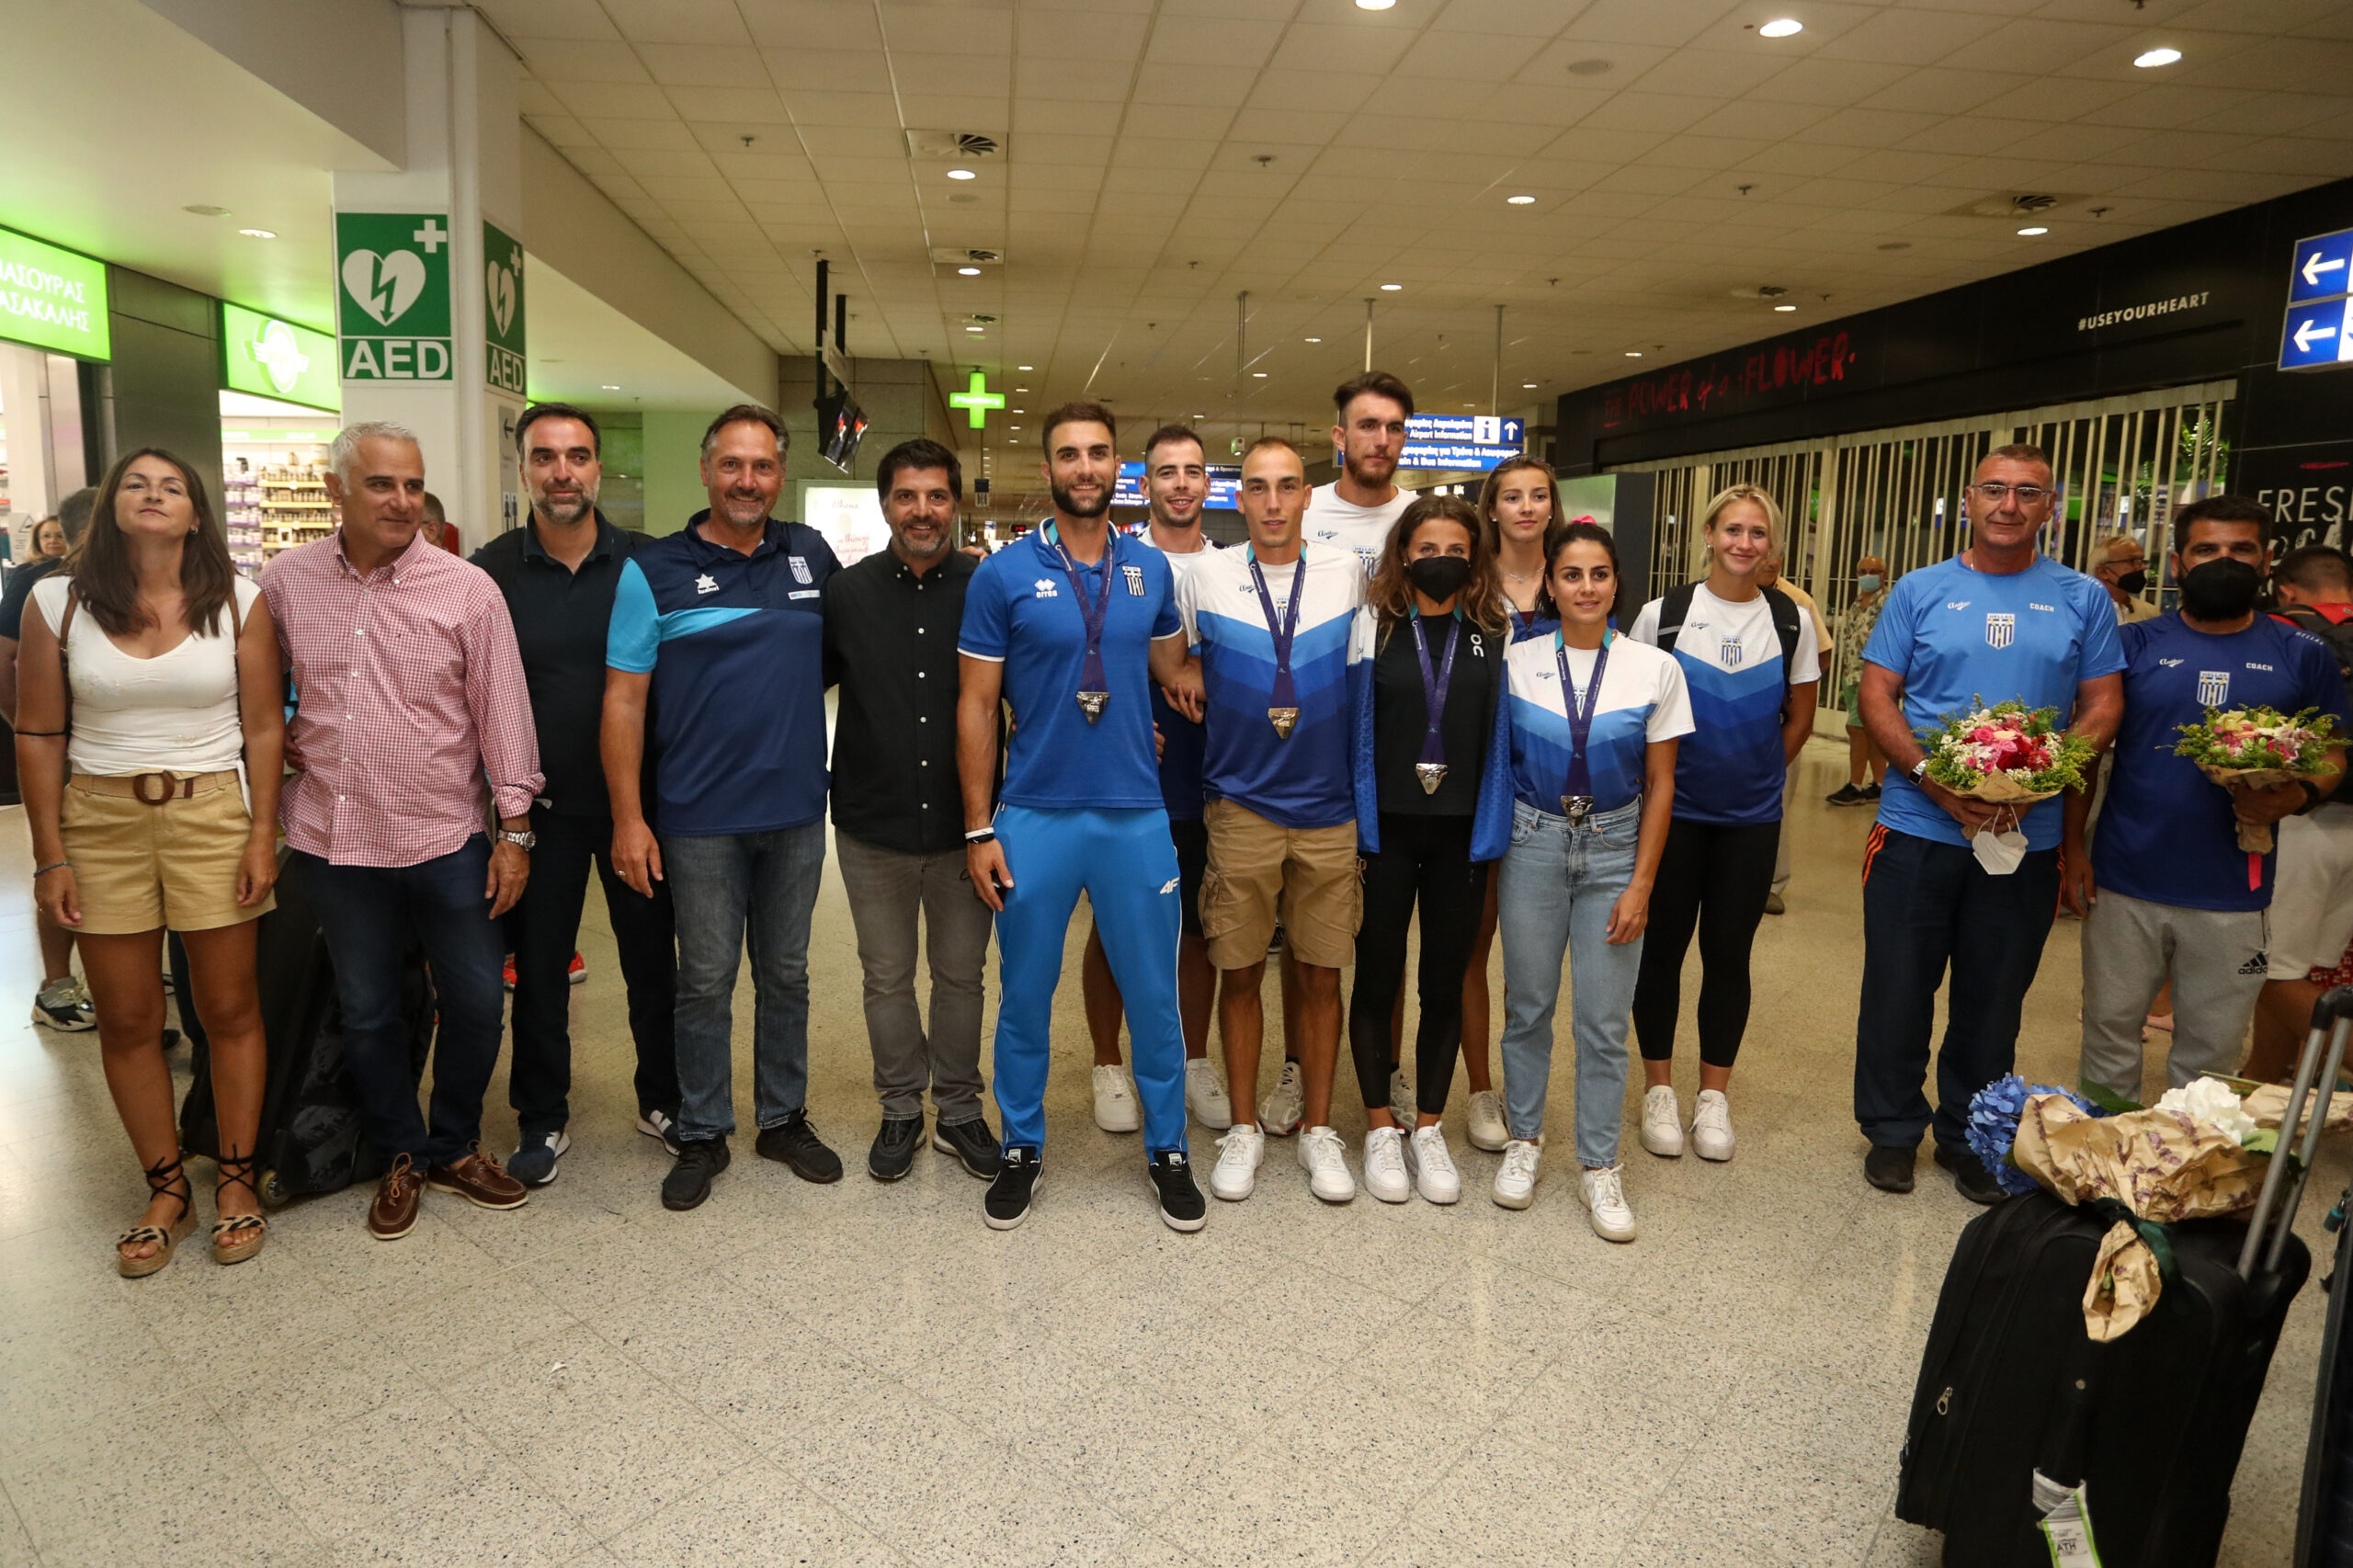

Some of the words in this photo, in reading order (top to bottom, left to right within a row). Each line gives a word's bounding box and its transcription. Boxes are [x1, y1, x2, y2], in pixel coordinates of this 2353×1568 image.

[0, 259, 85, 304] ΑΣΟΥΡΑΣ
[2078, 290, 2210, 331] #USEYOURHEART
[346, 340, 449, 379] AED
[489, 347, 524, 393] AED
[954, 395, 1001, 406] Pharmacy
[1409, 429, 1434, 439] Airport
[1434, 429, 1473, 440] Information
[1420, 457, 1436, 467] Bus
[1437, 457, 1482, 468] Information
[2029, 603, 2055, 613] COACH
[2245, 662, 2274, 672] COACH
[2237, 965, 2268, 975] adida
[2057, 1541, 2077, 1552] ATH
